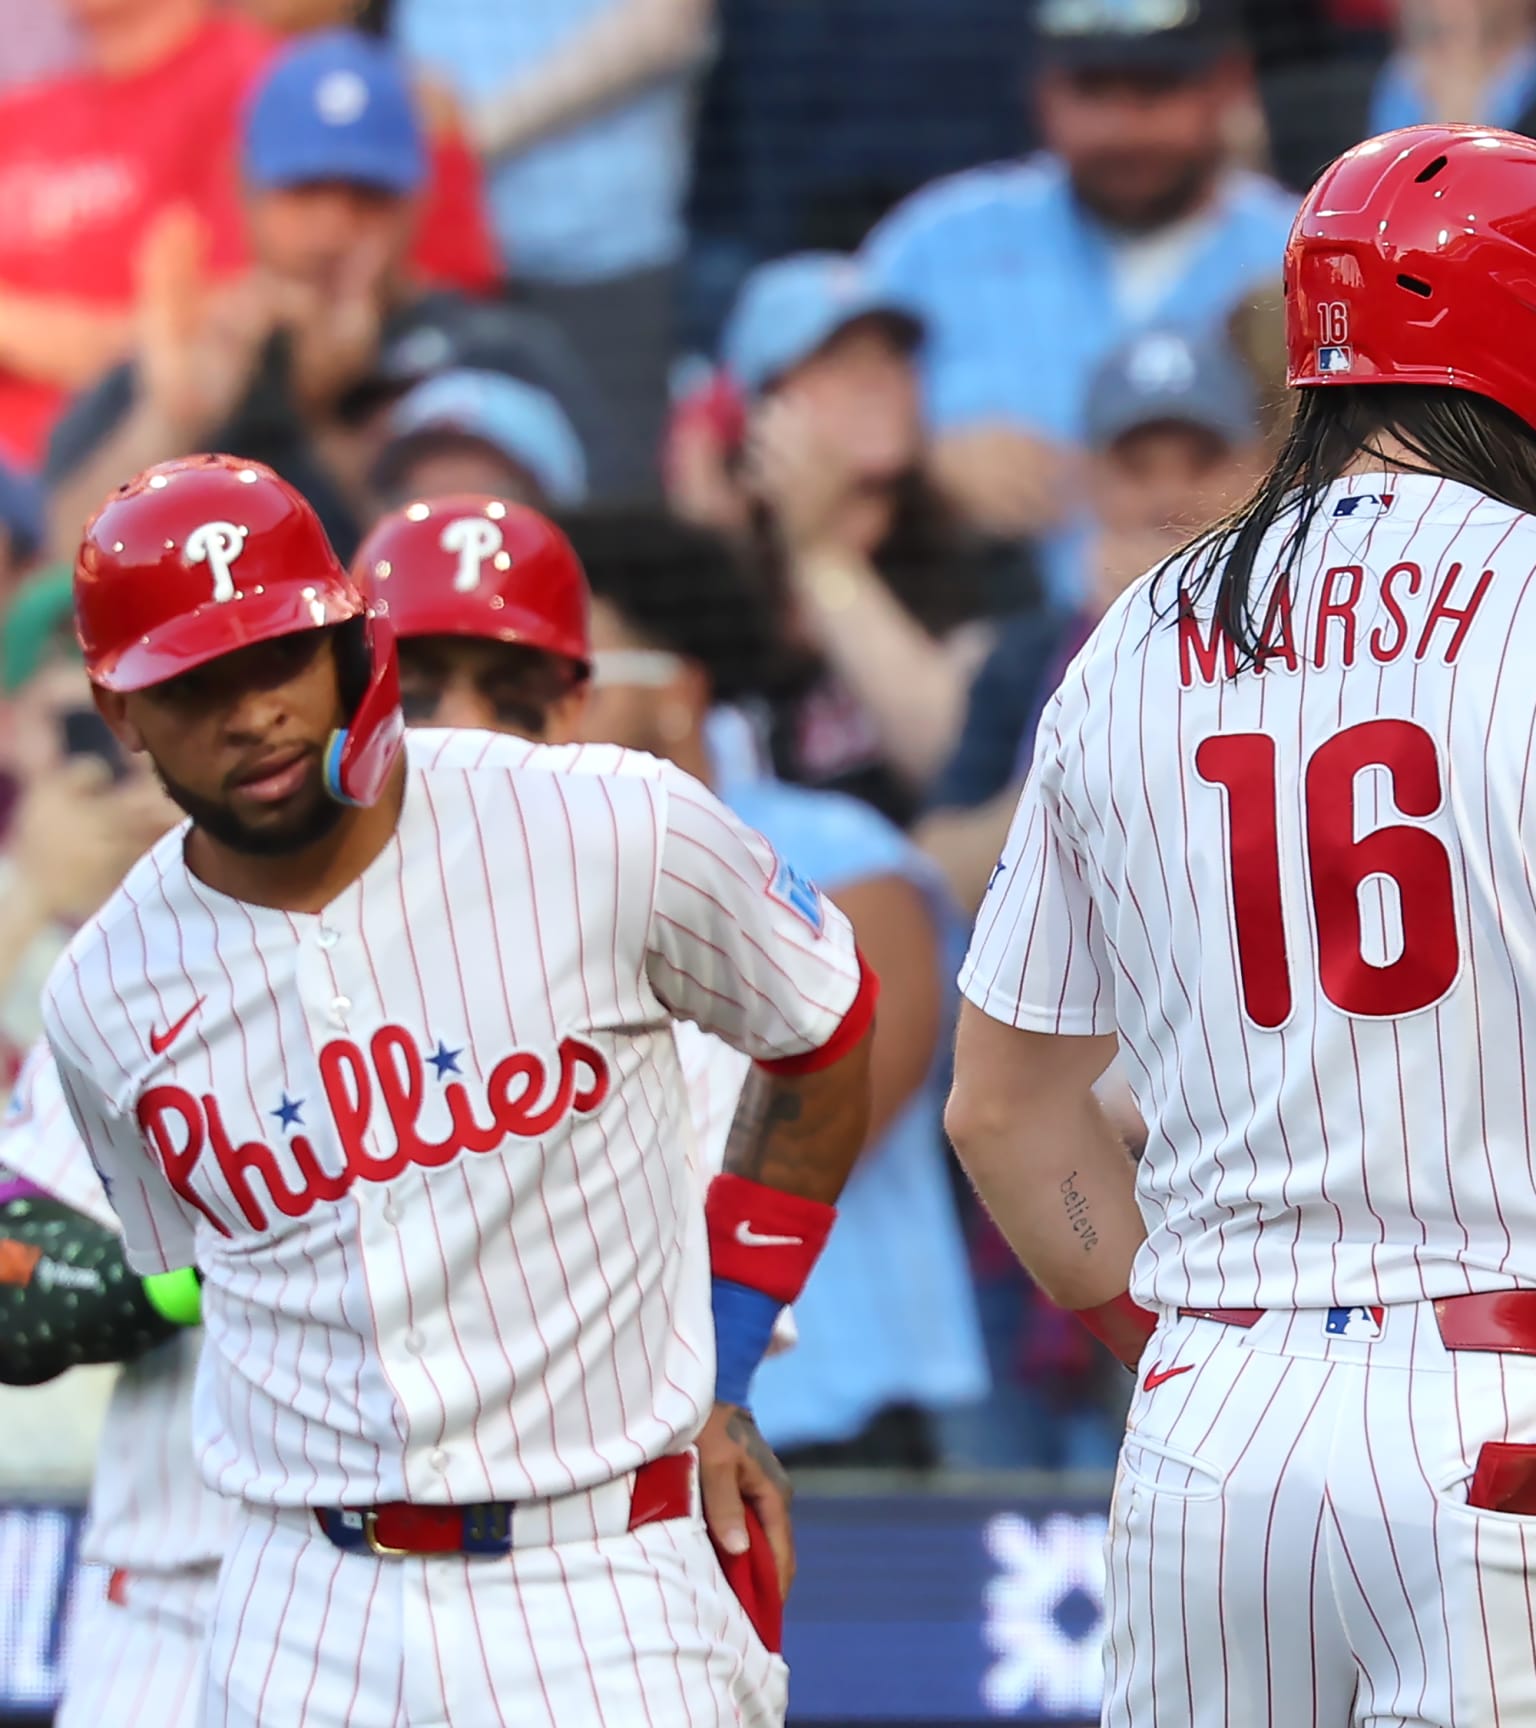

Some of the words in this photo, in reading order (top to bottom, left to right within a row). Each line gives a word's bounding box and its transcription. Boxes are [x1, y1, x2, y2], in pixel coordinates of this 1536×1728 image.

[1317, 301, 1348, 345] 16
[184, 520, 244, 603] P
[440, 516, 503, 593] P
[1177, 561, 1496, 690] MARSH
[1192, 716, 1464, 1031] 16
[136, 1023, 609, 1240] Phillies
[1060, 1170, 1099, 1252] believe
